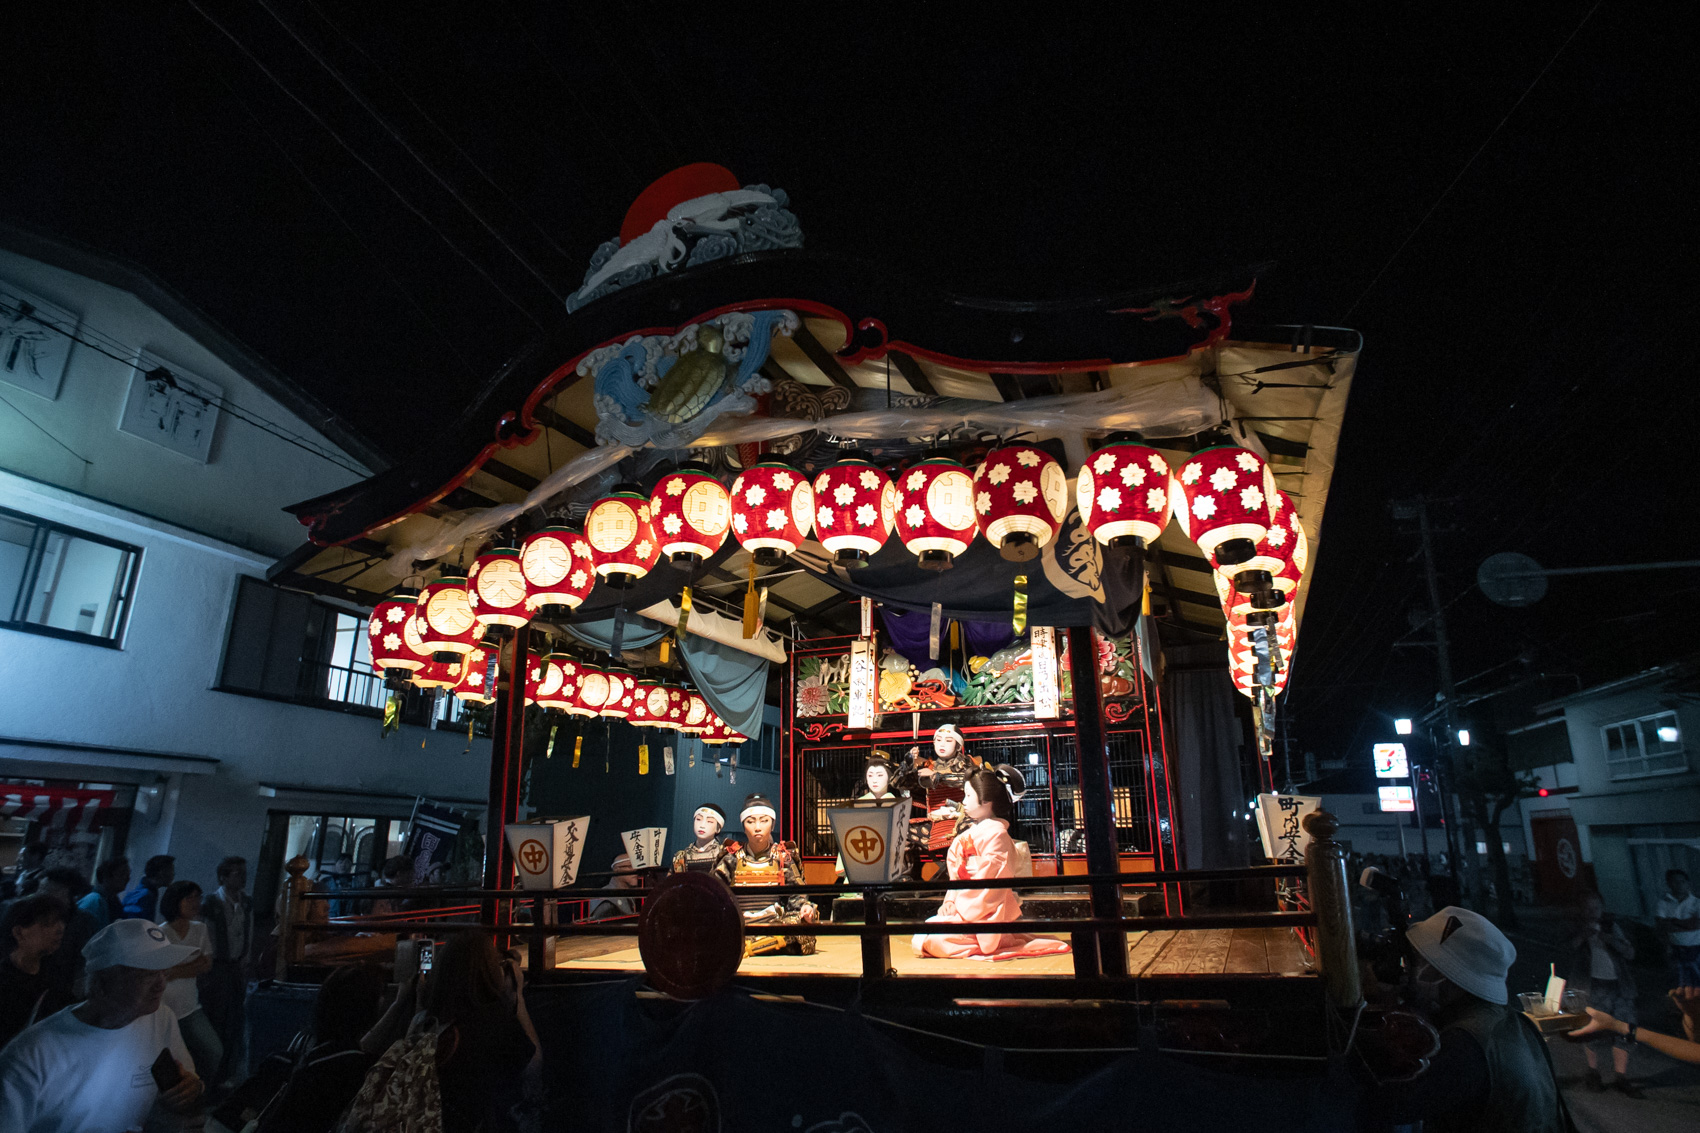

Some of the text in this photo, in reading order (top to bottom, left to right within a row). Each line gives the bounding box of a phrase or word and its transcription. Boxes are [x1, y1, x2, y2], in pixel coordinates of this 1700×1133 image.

[848, 828, 881, 863] 中
[1278, 796, 1304, 861] 町内安全
[521, 843, 546, 872] 中
[559, 821, 579, 886] 交通安全
[630, 830, 646, 867] 安全第一
